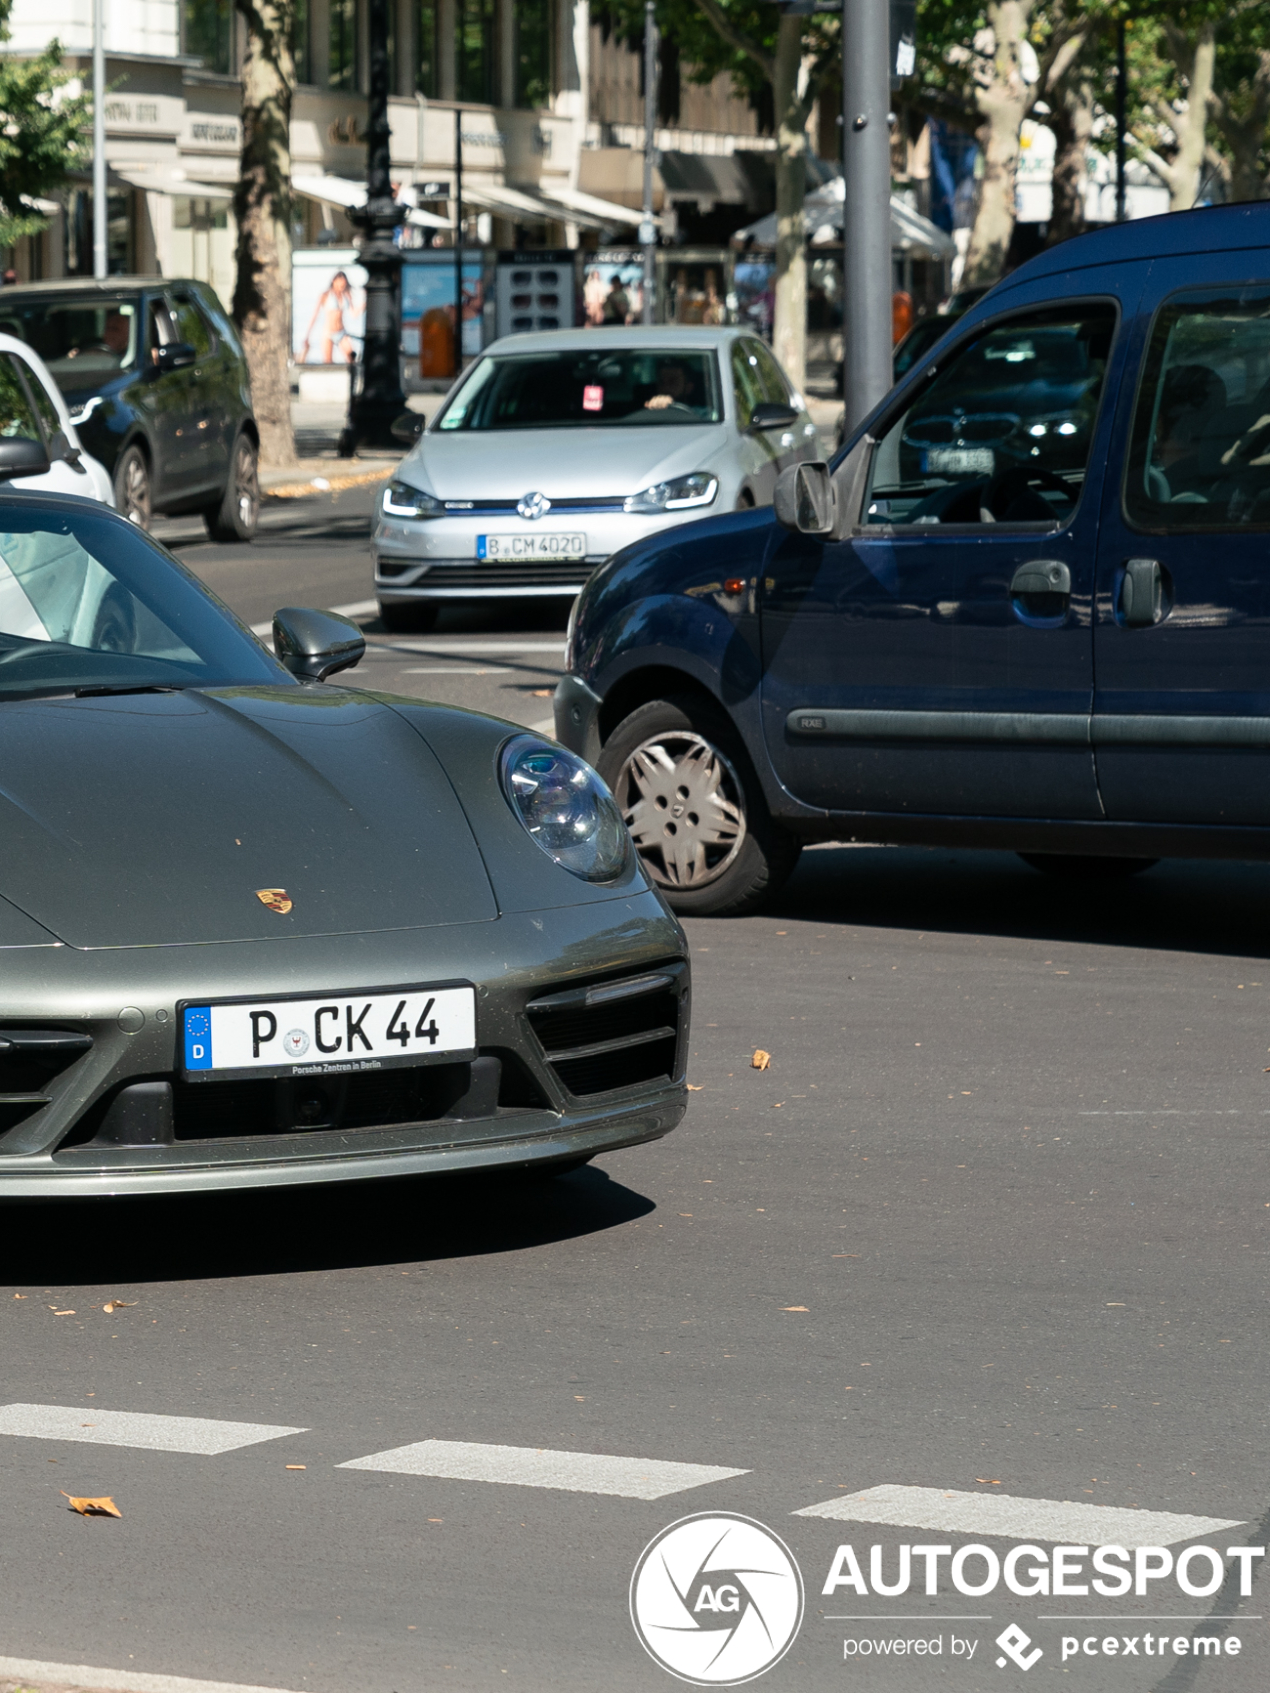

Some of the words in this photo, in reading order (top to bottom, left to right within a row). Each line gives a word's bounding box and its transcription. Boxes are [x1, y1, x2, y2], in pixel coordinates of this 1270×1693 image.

[801, 718, 823, 729] RXE
[249, 1010, 277, 1058] P
[314, 1003, 373, 1053] CK
[386, 998, 440, 1047] 44
[192, 1044, 204, 1059] D
[292, 1065, 322, 1075] Porsche
[322, 1063, 351, 1072] Zentren
[352, 1062, 359, 1070] in
[360, 1060, 381, 1069] Berlin
